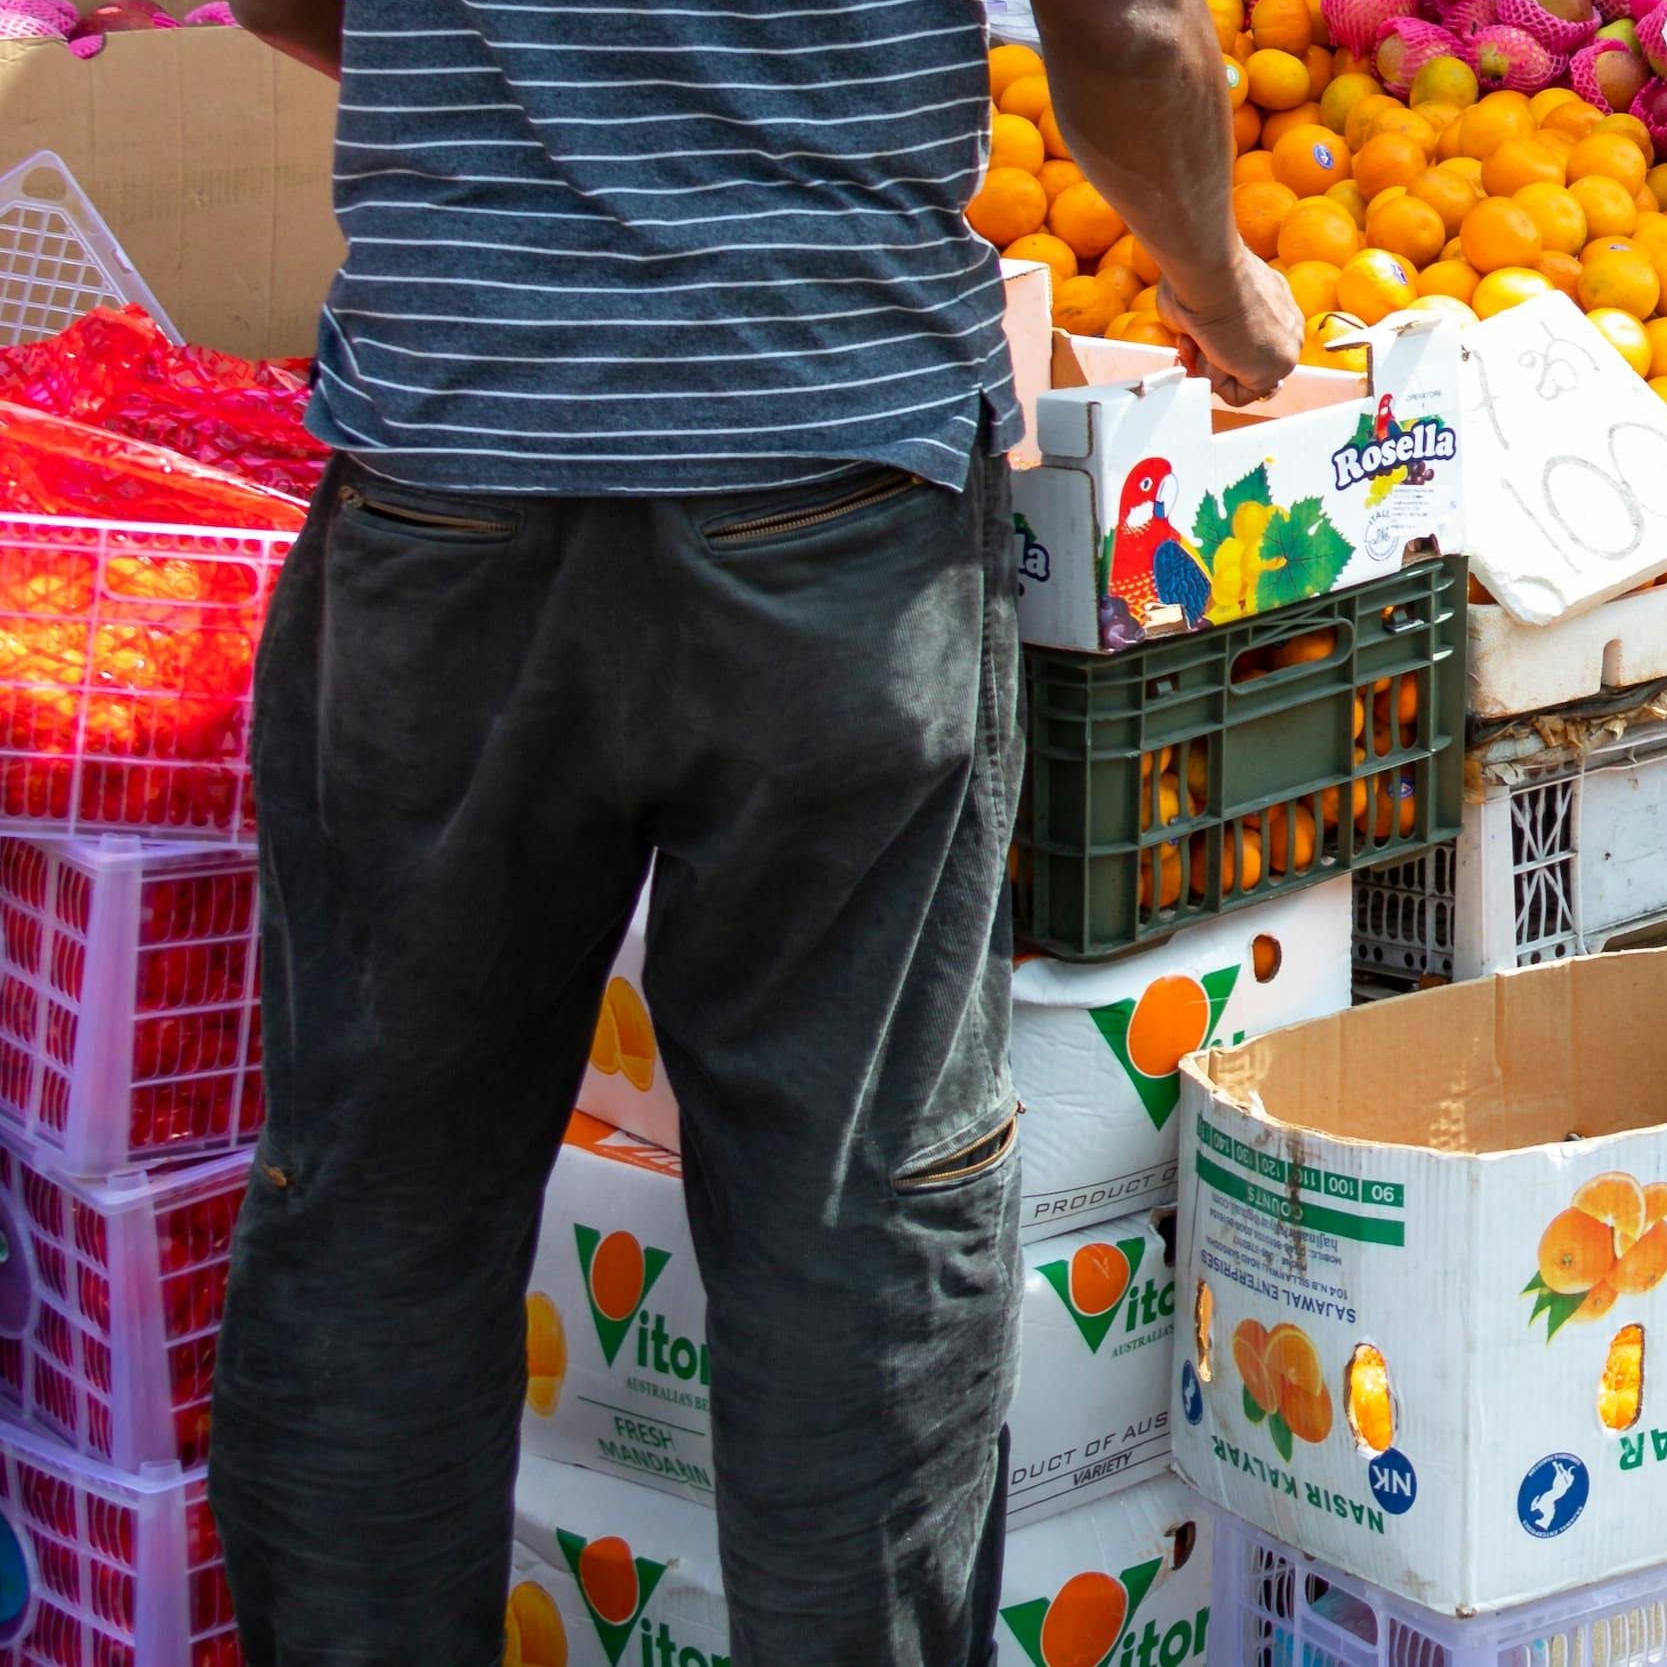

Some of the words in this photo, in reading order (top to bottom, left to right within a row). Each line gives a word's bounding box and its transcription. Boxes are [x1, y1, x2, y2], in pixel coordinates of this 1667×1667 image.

[1333, 420, 1457, 491] Rosella
[1034, 1172, 1156, 1218] PRODUCT
[1261, 1157, 1281, 1178] 120
[1328, 1176, 1355, 1197] 100
[1371, 1185, 1395, 1203] 90
[1246, 1185, 1303, 1221] COUNTS
[1198, 1249, 1279, 1301] ENTERPRISES
[1281, 1289, 1357, 1324] SAJAWAL
[1328, 1286, 1349, 1302] 104
[614, 1416, 674, 1448] FRESH
[1085, 1432, 1116, 1459] OF
[598, 1438, 712, 1487] MANDARIN
[1072, 1450, 1132, 1486] VARIETY
[1372, 1464, 1411, 1497] NK
[1210, 1435, 1298, 1500] KALYAR
[1304, 1482, 1385, 1535] NASIR
